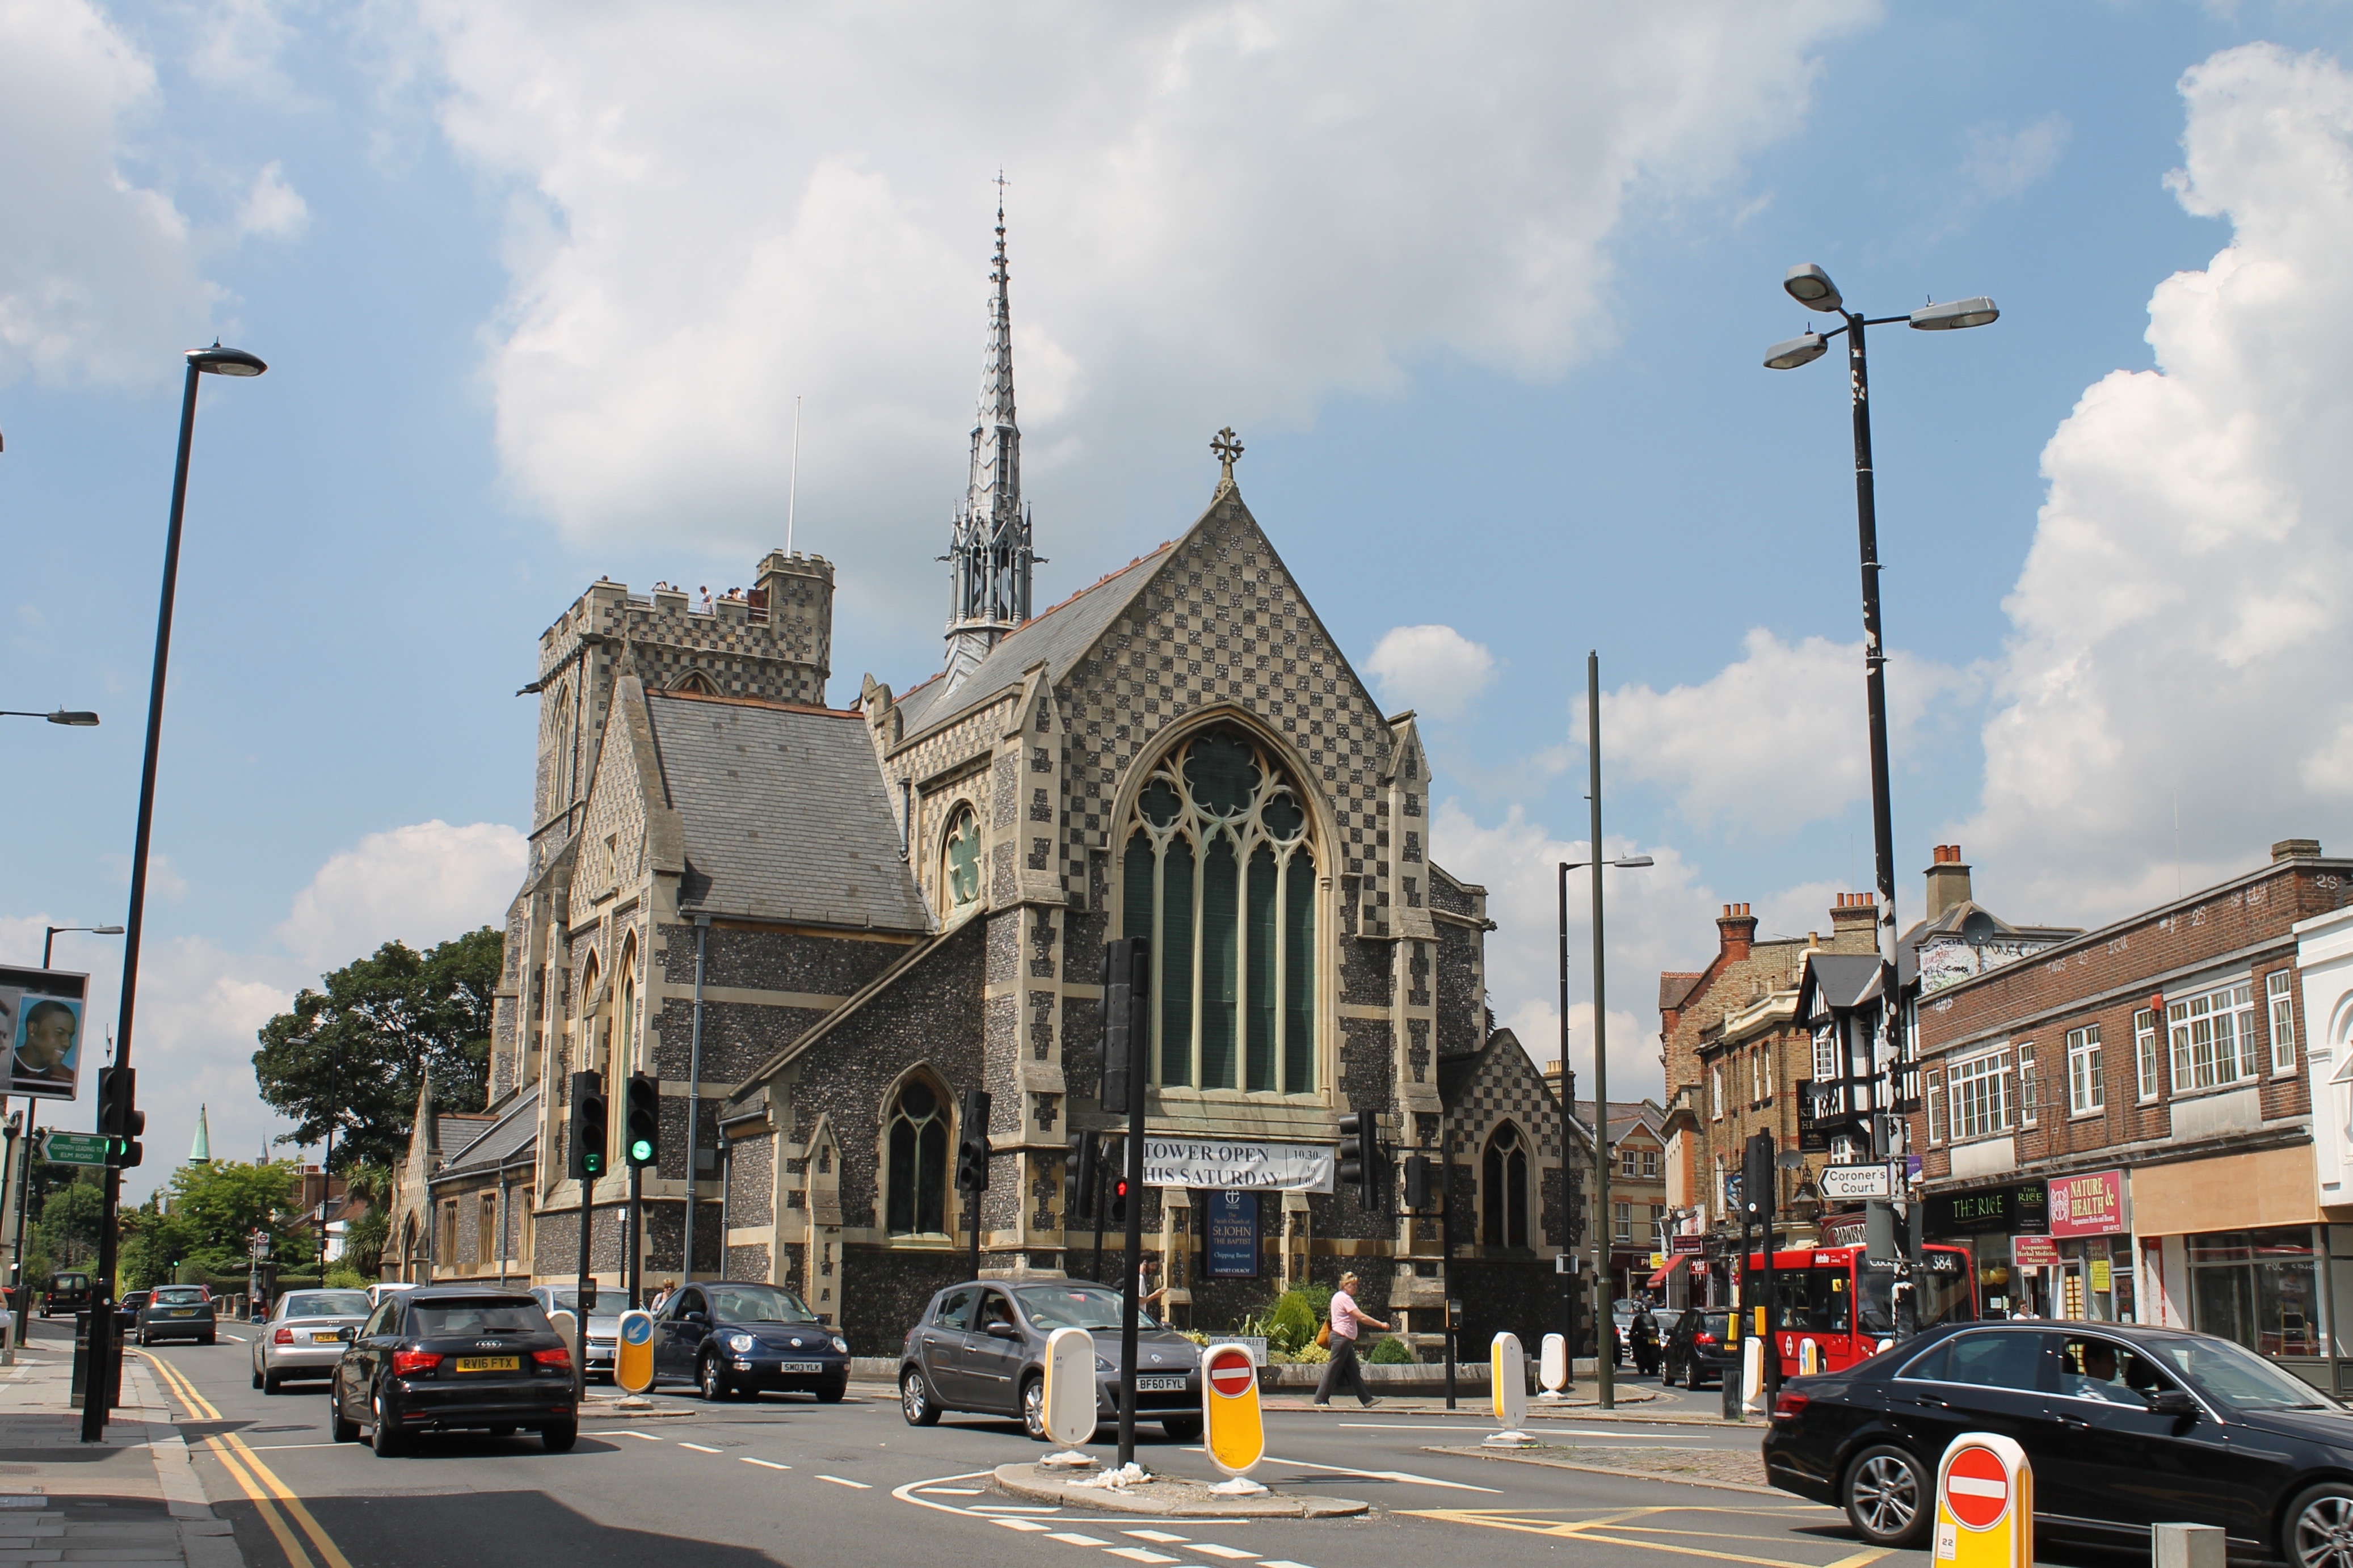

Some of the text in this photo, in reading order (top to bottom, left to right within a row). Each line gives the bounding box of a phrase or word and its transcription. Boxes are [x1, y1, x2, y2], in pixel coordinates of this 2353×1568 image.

[1143, 1143, 1269, 1163] TOWER OPEN
[1143, 1166, 1281, 1187] HIS SATURDAY
[1829, 1169, 1886, 1182] Coroner's
[1841, 1182, 1875, 1193] Court
[2070, 1177, 2103, 1198] NATURE
[2105, 1183, 2115, 1207] &
[2018, 1192, 2043, 1202] RICE
[1953, 1195, 2003, 1218] THE RICE
[2071, 1196, 2104, 1217] HEALTH
[1932, 1255, 1952, 1270] 384
[463, 1358, 512, 1369] RV16 FTX
[1140, 1379, 1183, 1389] BF60 FYL
[1942, 1537, 1954, 1547] 22
